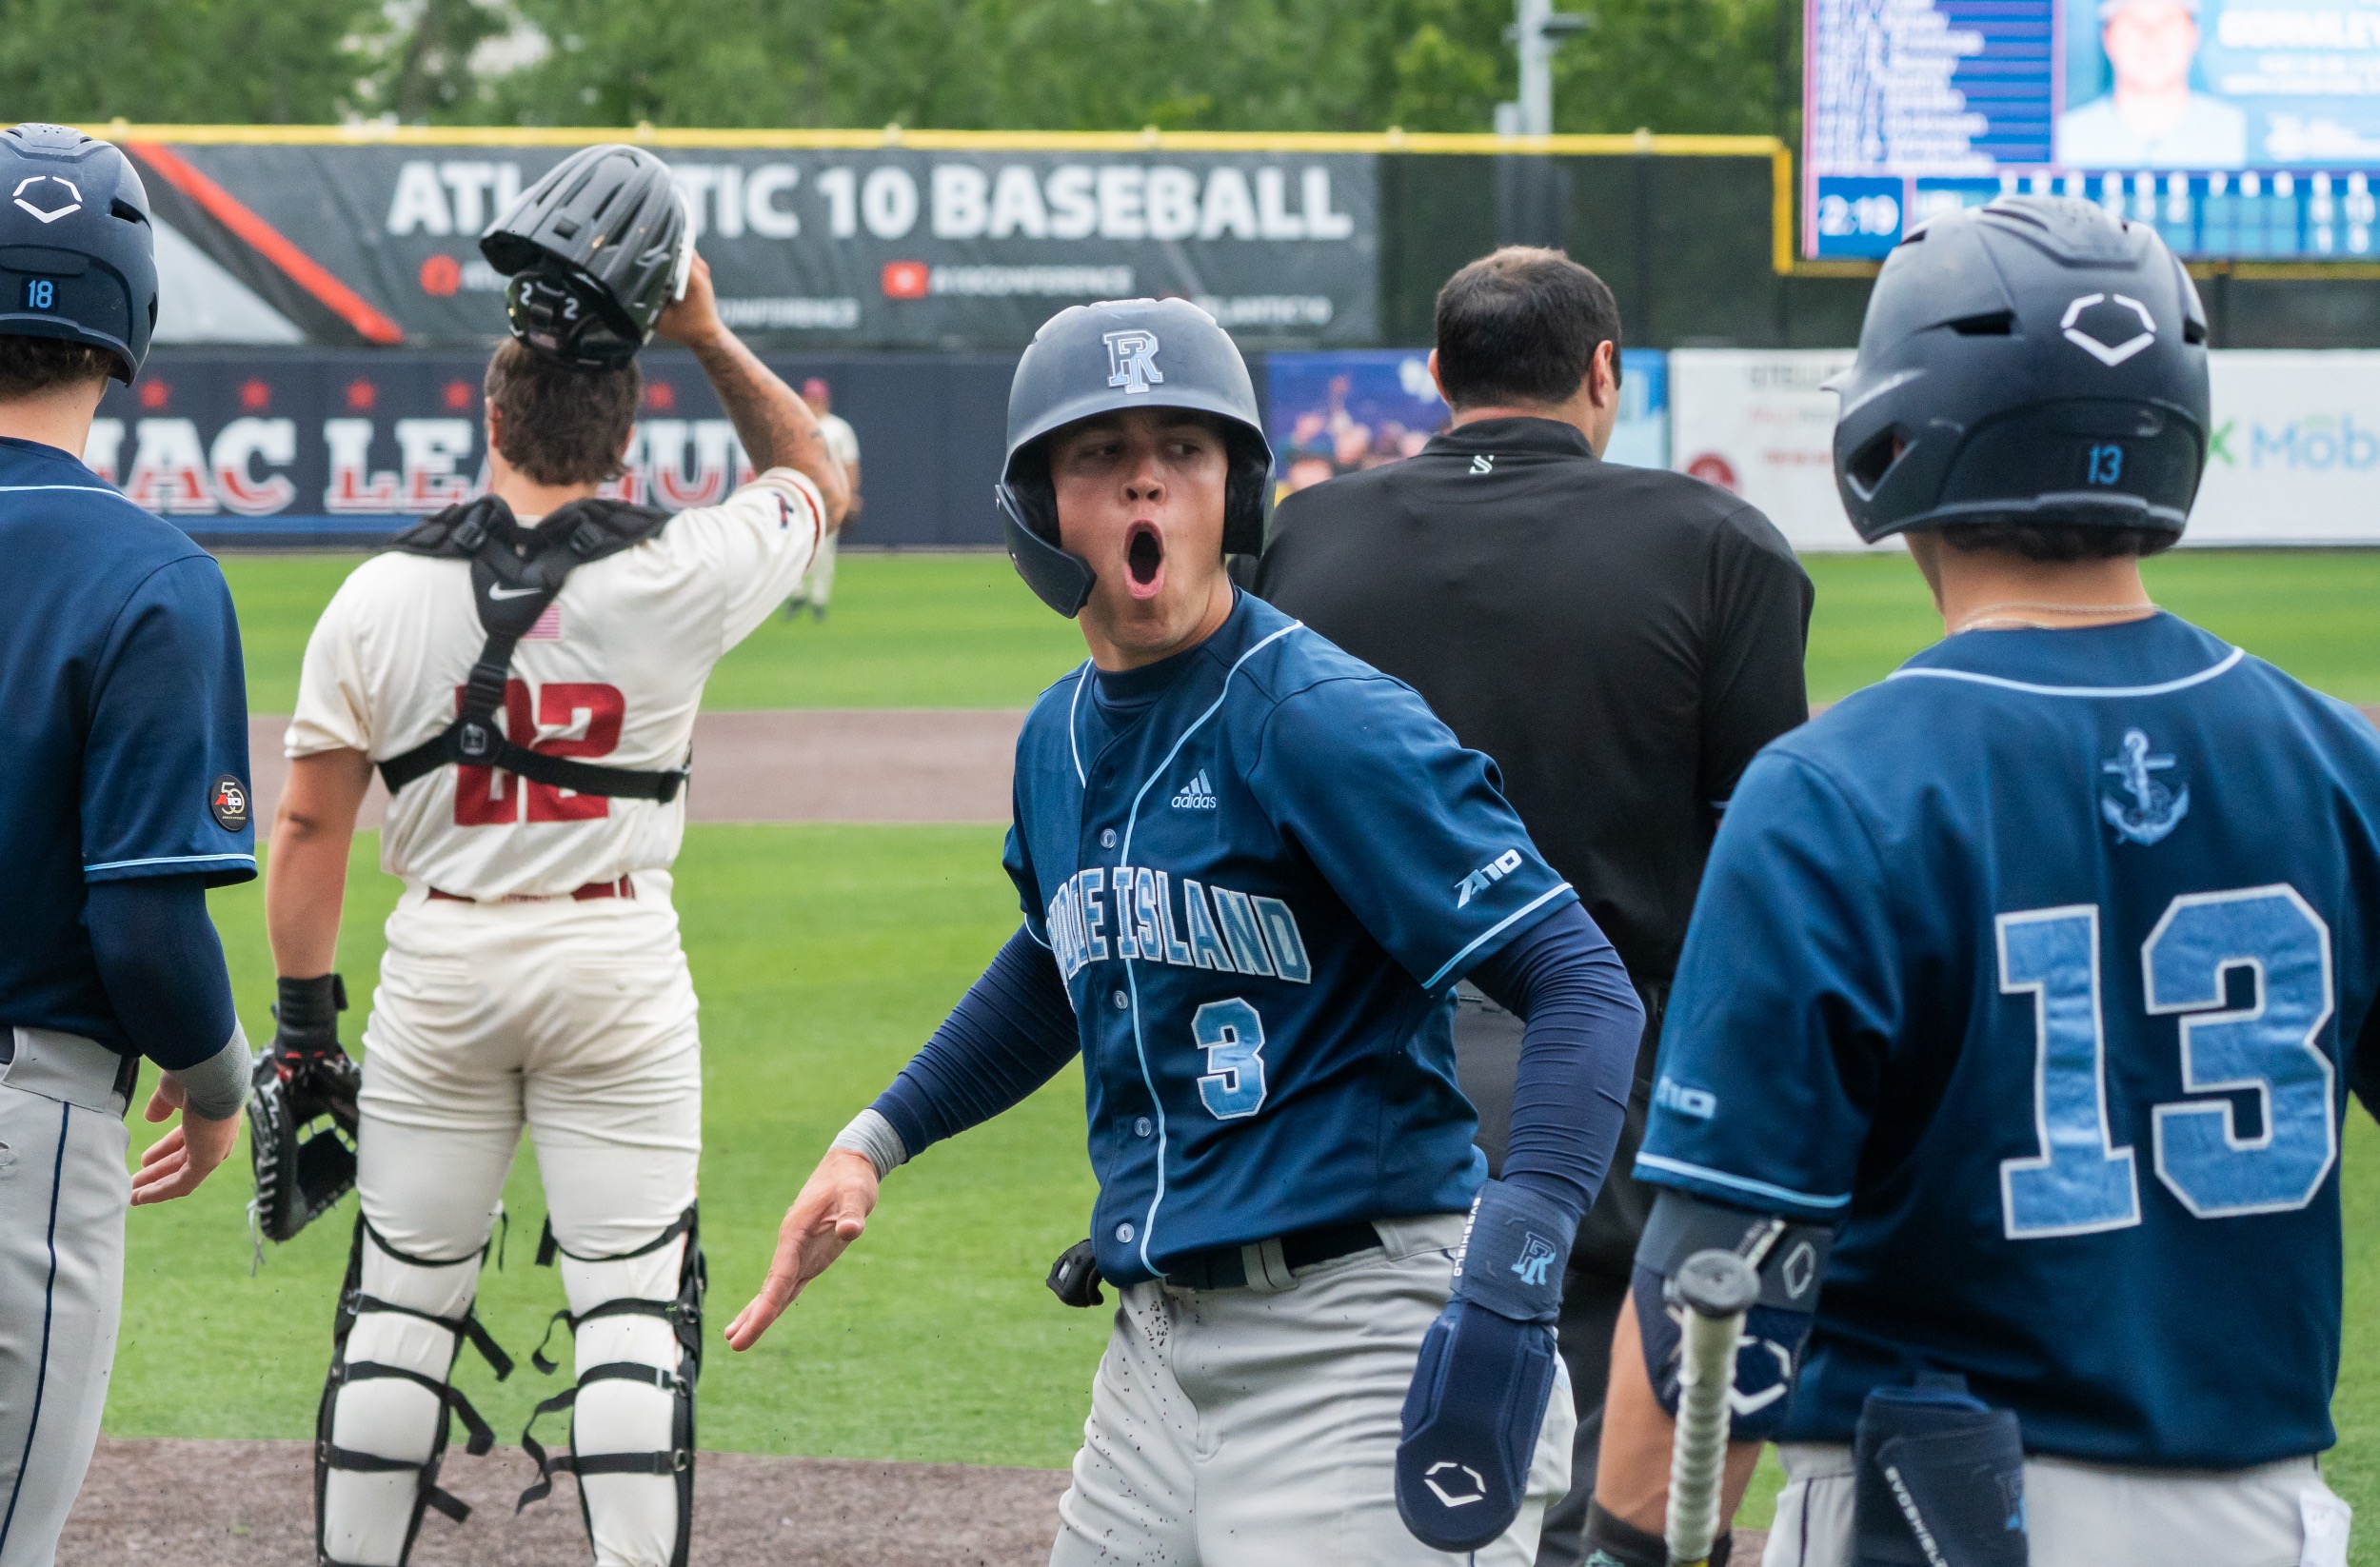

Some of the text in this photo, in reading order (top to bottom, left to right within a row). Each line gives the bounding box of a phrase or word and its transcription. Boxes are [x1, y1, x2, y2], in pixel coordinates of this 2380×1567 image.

[817, 165, 921, 240] 10
[930, 165, 1355, 241] BASEBALL
[29, 280, 53, 308] 18
[2089, 445, 2124, 485] 13
[1172, 793, 1217, 809] adidas
[1454, 849, 1522, 909] A10
[1113, 866, 1312, 984] ISLAND
[1190, 997, 1268, 1120] 3
[1995, 883, 2337, 1240] 13
